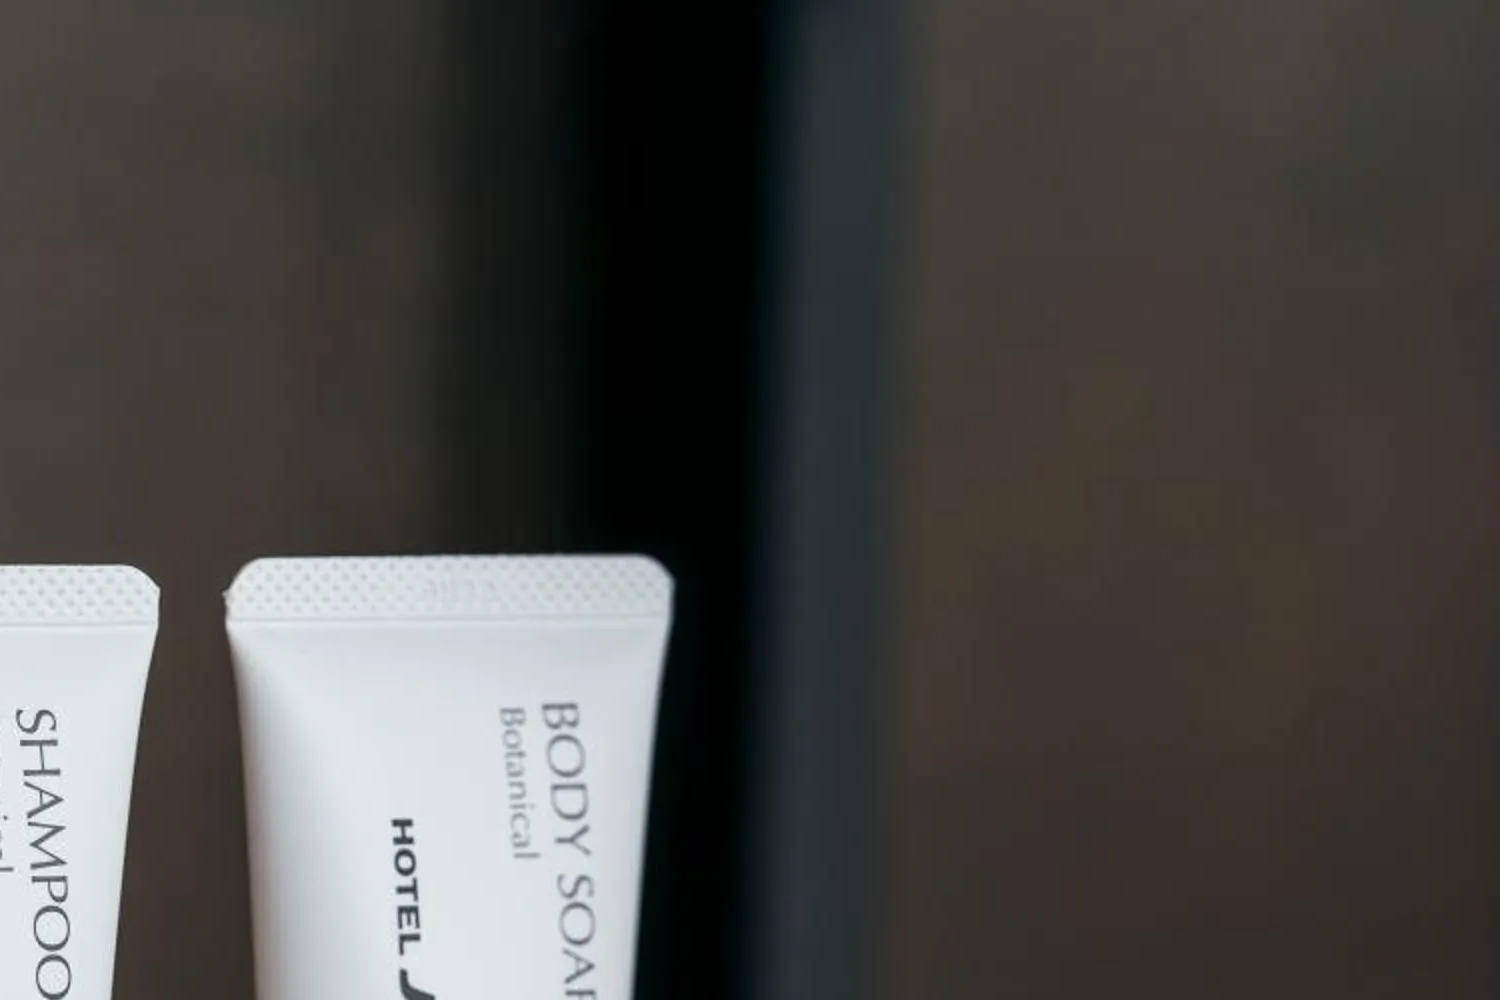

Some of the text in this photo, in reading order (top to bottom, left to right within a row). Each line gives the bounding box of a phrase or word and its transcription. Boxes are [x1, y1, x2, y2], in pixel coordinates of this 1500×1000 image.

[14, 708, 73, 1000] SHAMPOO
[499, 706, 542, 859] Botanical
[541, 702, 592, 857] BODY
[391, 818, 422, 956] HOTEL
